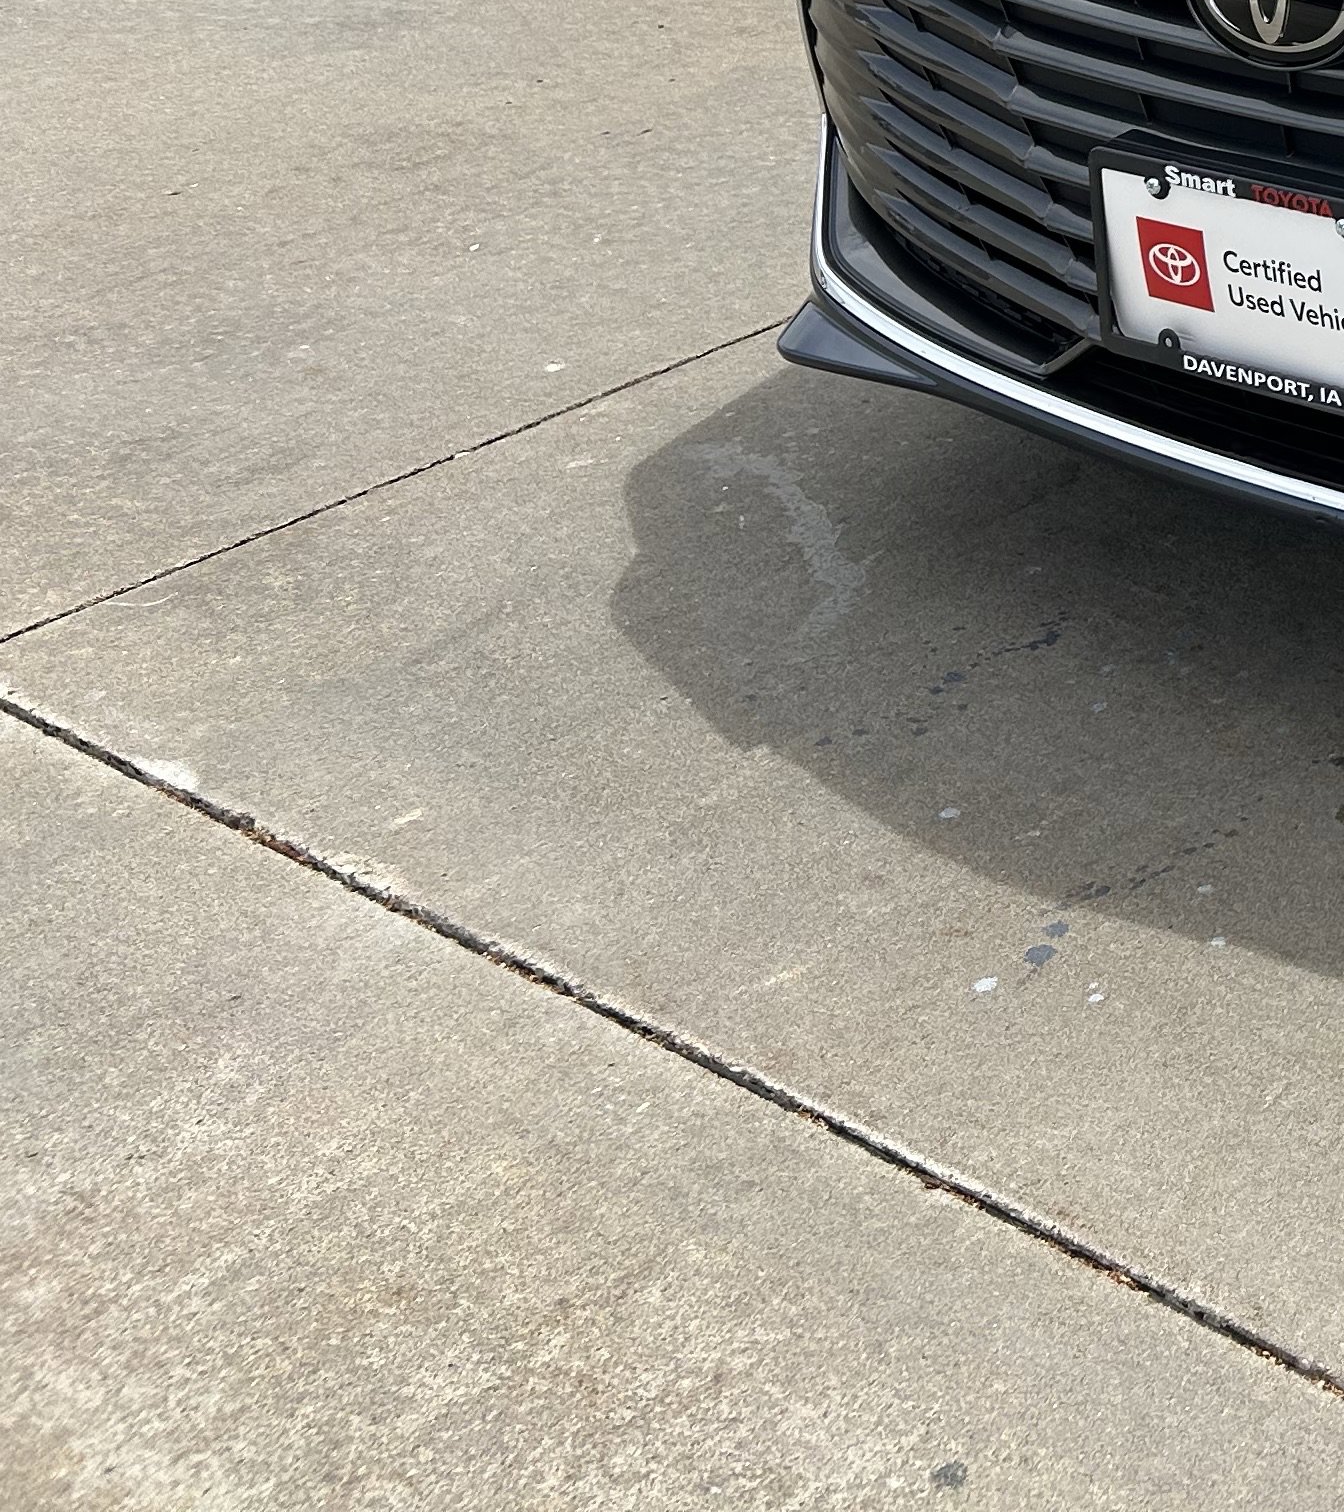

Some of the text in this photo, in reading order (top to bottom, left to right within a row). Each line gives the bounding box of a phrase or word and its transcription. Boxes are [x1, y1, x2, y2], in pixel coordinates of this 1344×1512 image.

[1164, 165, 1334, 218] Smart TOYOTA
[1223, 250, 1323, 293] Certified
[1227, 284, 1286, 318] Used
[1182, 354, 1343, 407] DAVENPORT, IA
